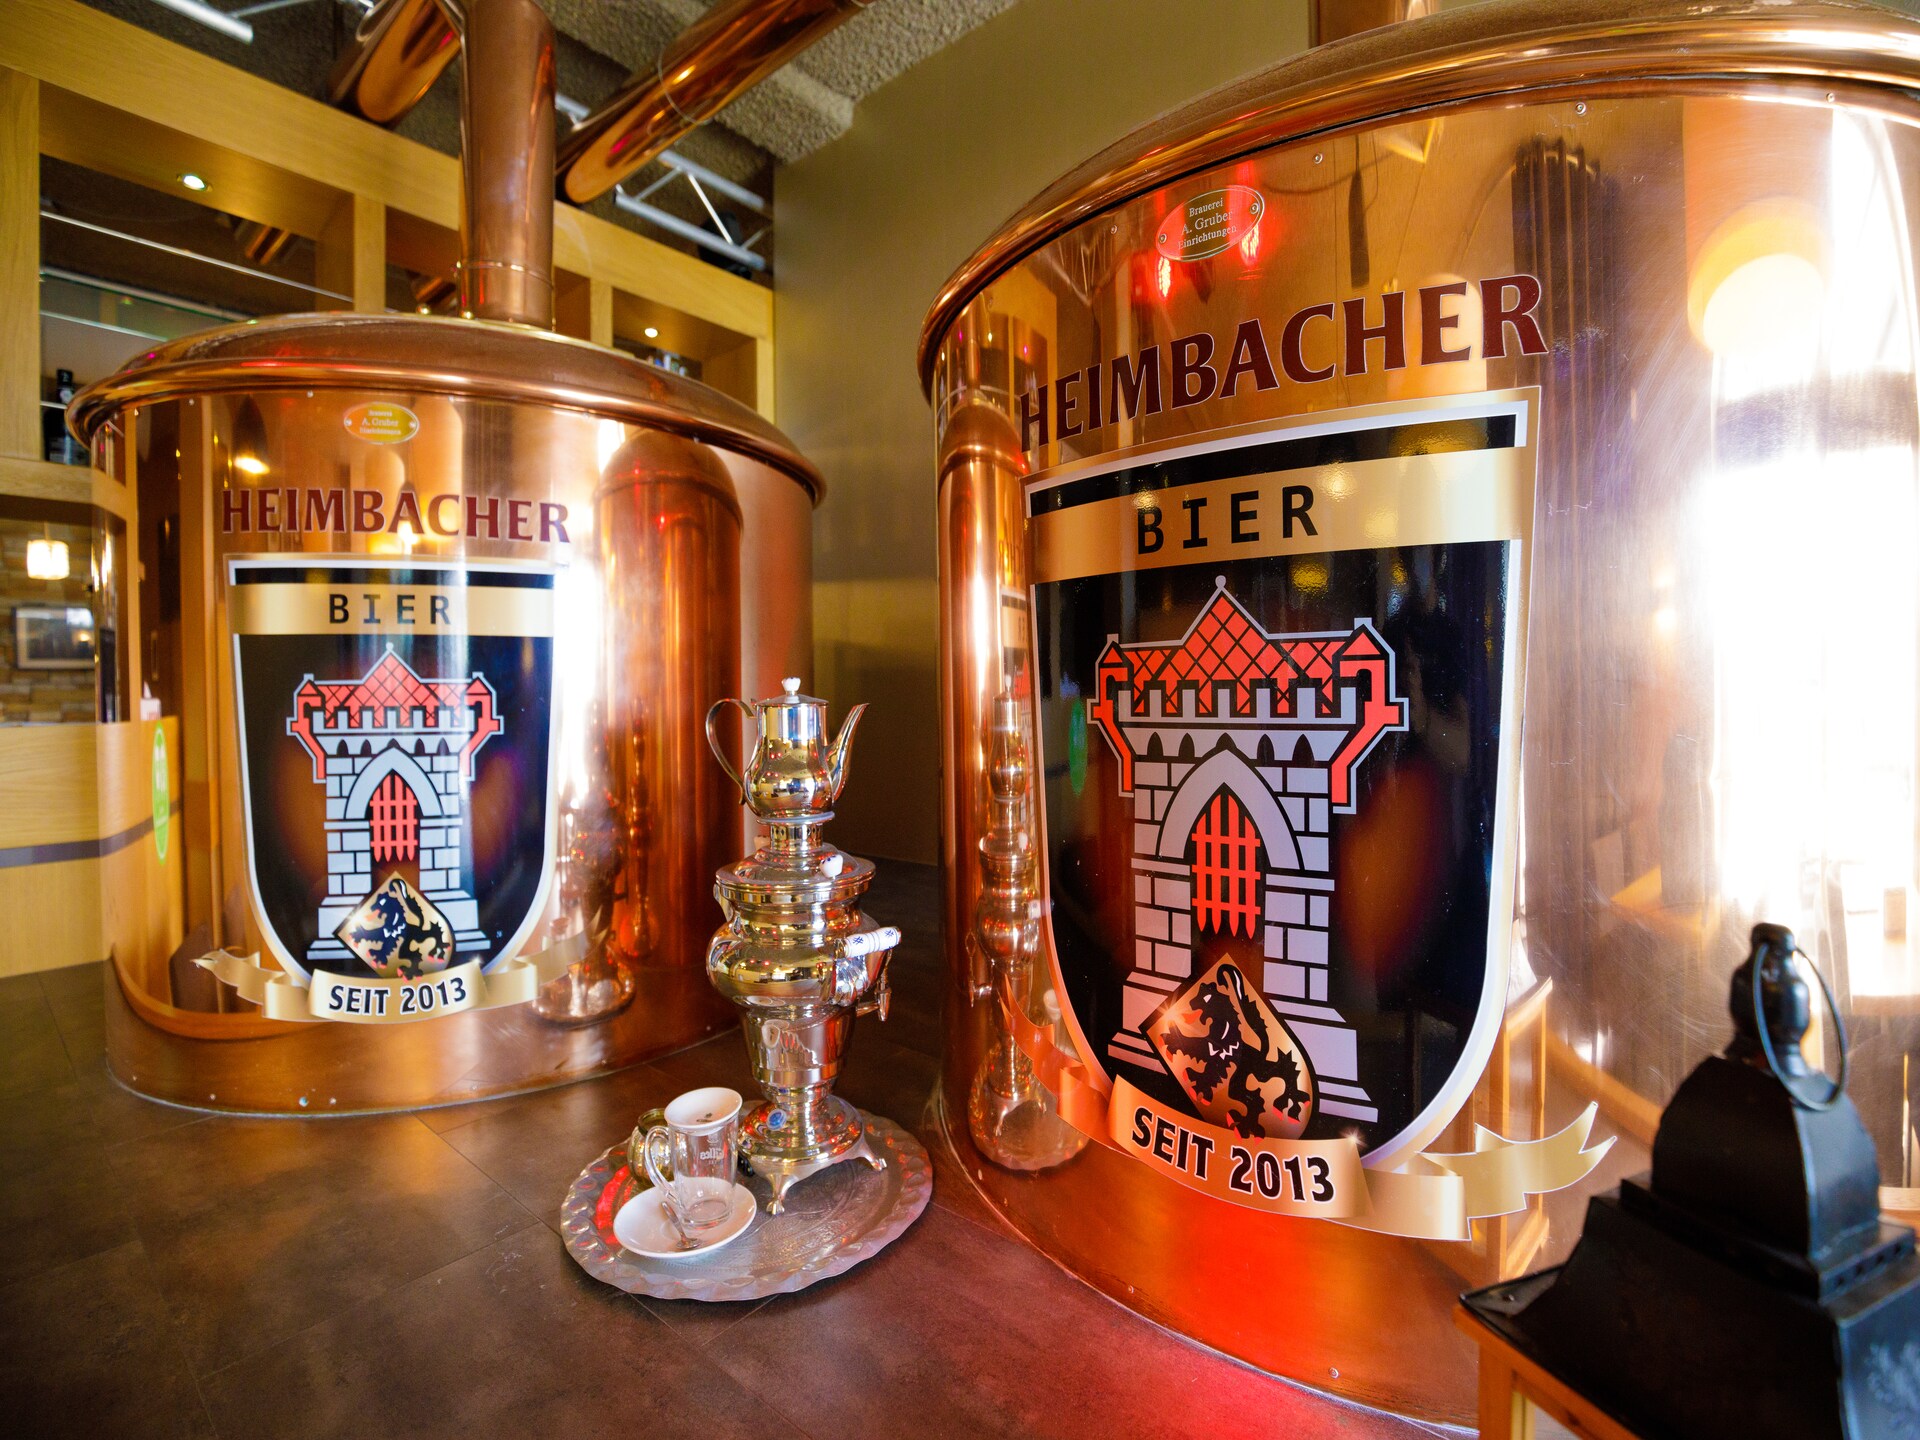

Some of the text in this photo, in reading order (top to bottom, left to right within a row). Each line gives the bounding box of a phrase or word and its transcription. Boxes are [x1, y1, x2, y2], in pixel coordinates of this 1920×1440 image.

[1181, 210, 1234, 235] A. Gruber
[1188, 198, 1224, 217] Brauerei
[1177, 225, 1237, 249] Einrichtungen
[1020, 274, 1549, 452] HEIMBACHER
[222, 487, 571, 544] HEIMBACHER
[1136, 485, 1319, 555] BIER
[328, 593, 452, 625] BIER
[328, 976, 468, 1016] SEIT 2013
[1131, 1106, 1335, 1203] SEIT 2013
